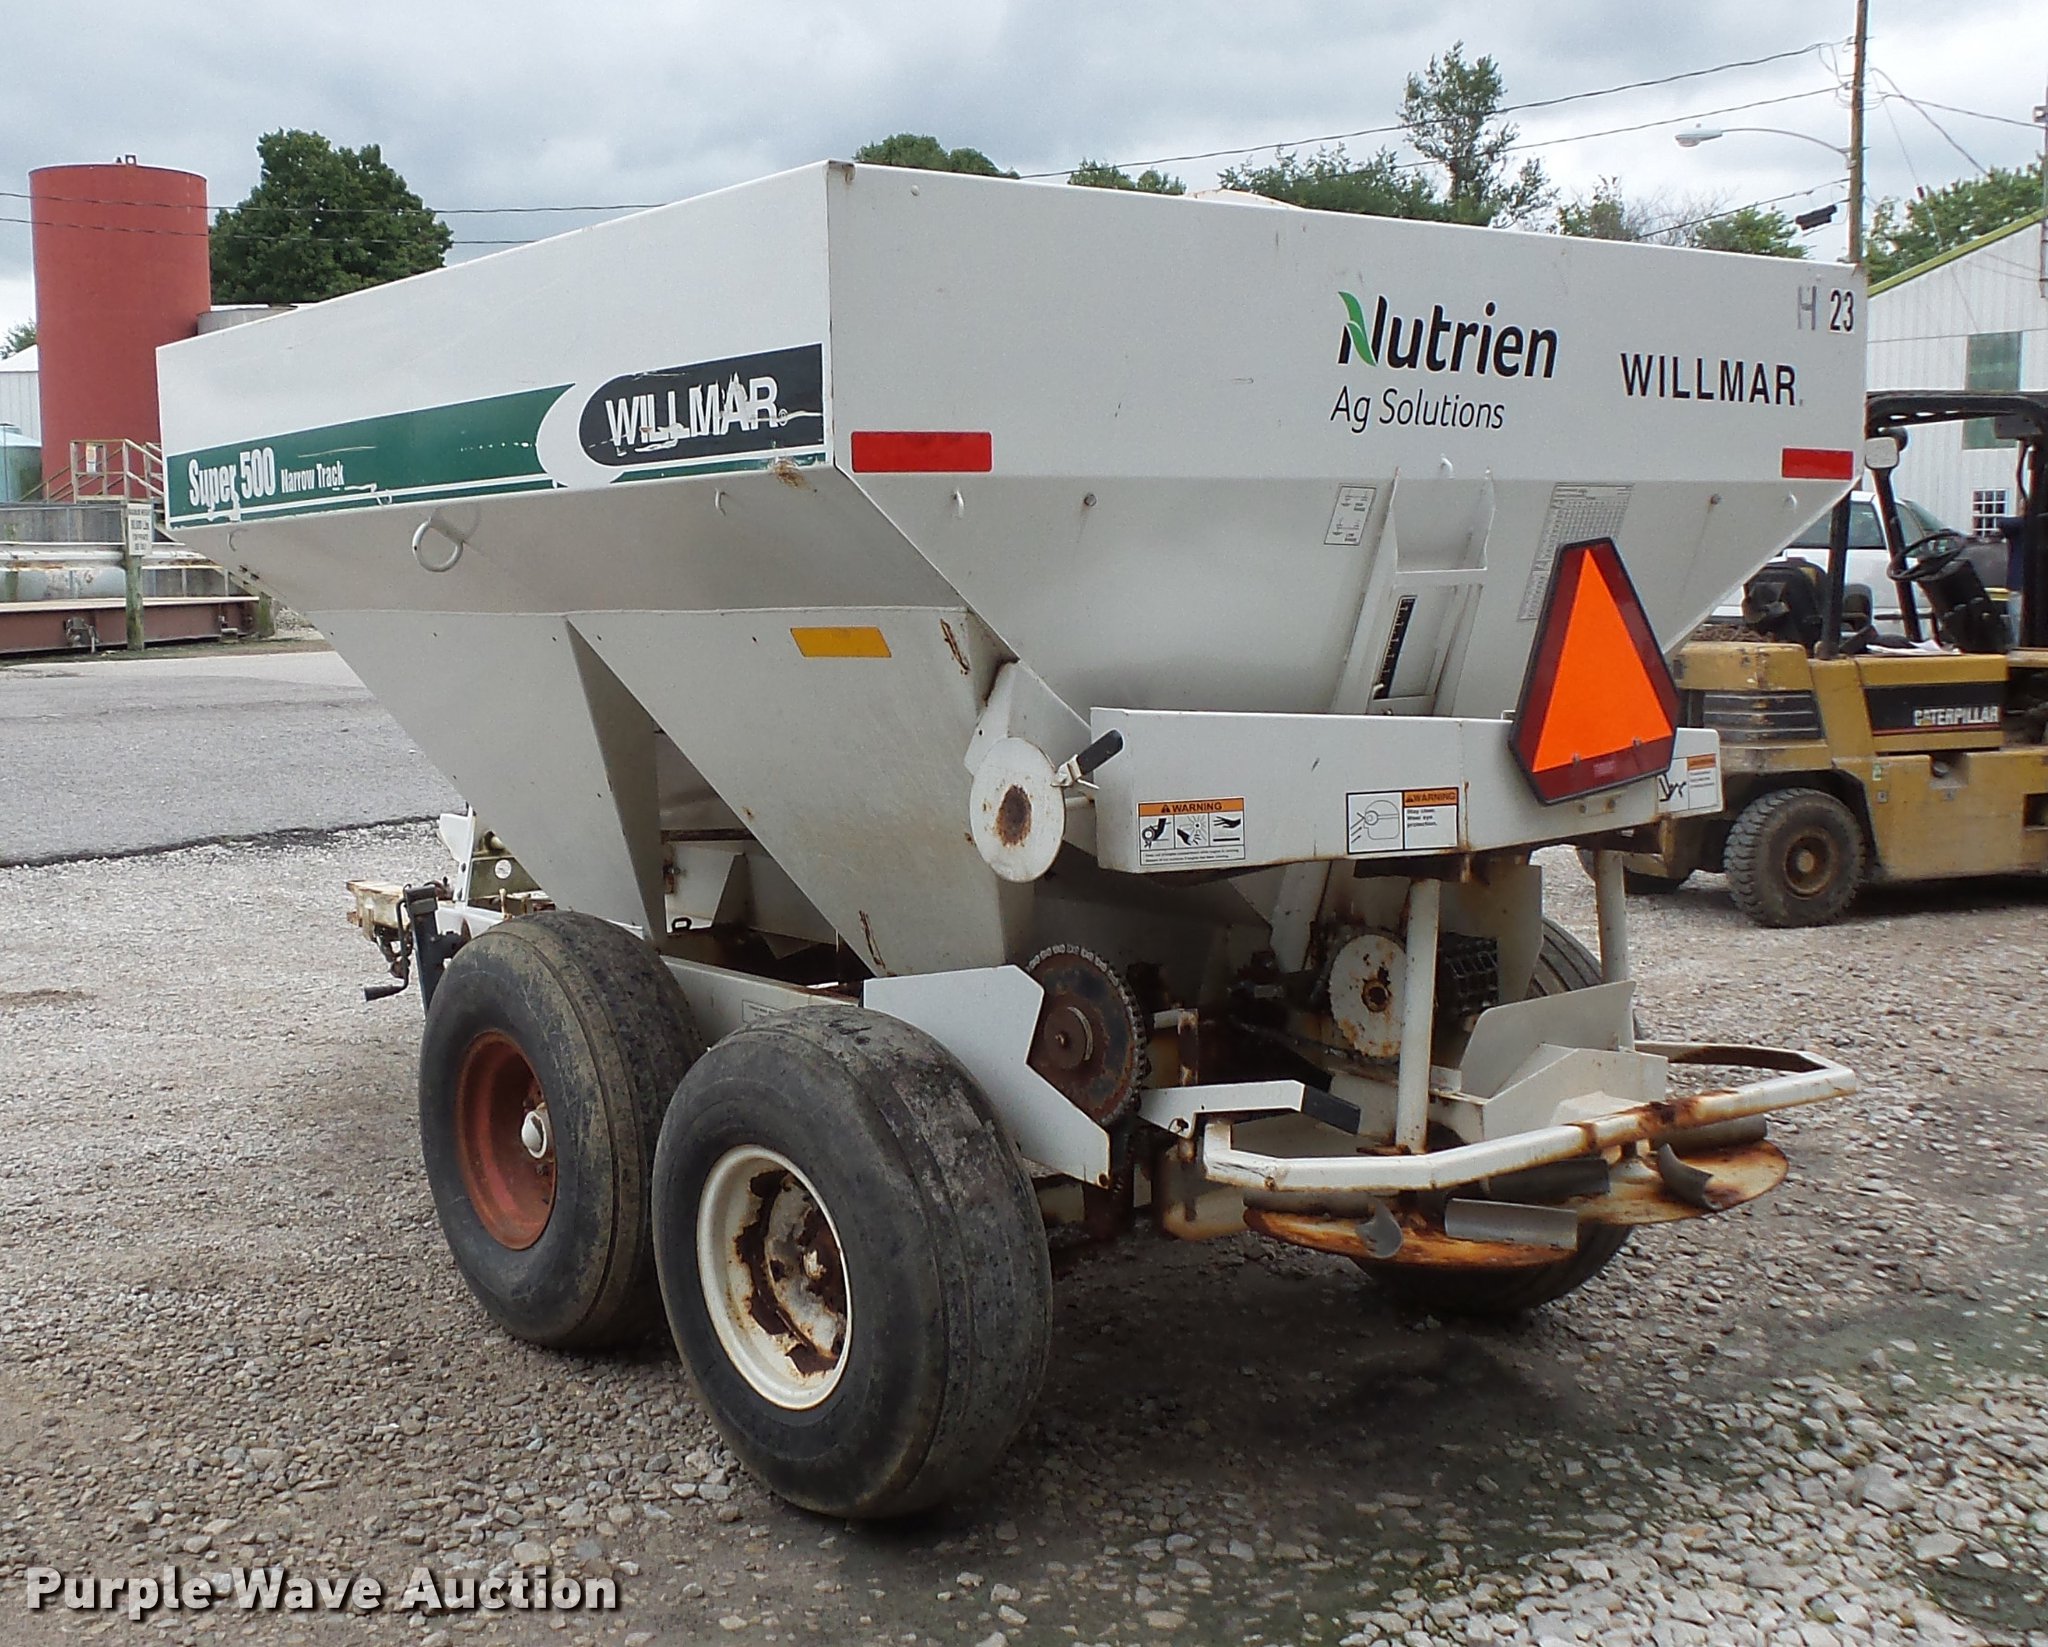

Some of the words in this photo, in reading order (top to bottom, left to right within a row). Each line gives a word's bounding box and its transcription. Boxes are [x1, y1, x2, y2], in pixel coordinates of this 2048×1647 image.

[1797, 285, 1817, 330] H
[1829, 289, 1855, 332] 23
[1338, 291, 1558, 379] Nutrien
[1620, 353, 1796, 406] WILLMAR
[605, 376, 779, 447] WILLMAR
[1330, 385, 1371, 434] Ag
[1379, 388, 1505, 429] Solutions
[188, 459, 237, 508] Super
[239, 447, 276, 500] 500
[281, 469, 315, 494] Narrow
[316, 460, 345, 489] Track
[1914, 706, 1999, 727] CATERPILLAR
[1172, 802, 1223, 813] WARNING
[1413, 791, 1456, 802] WARNING
